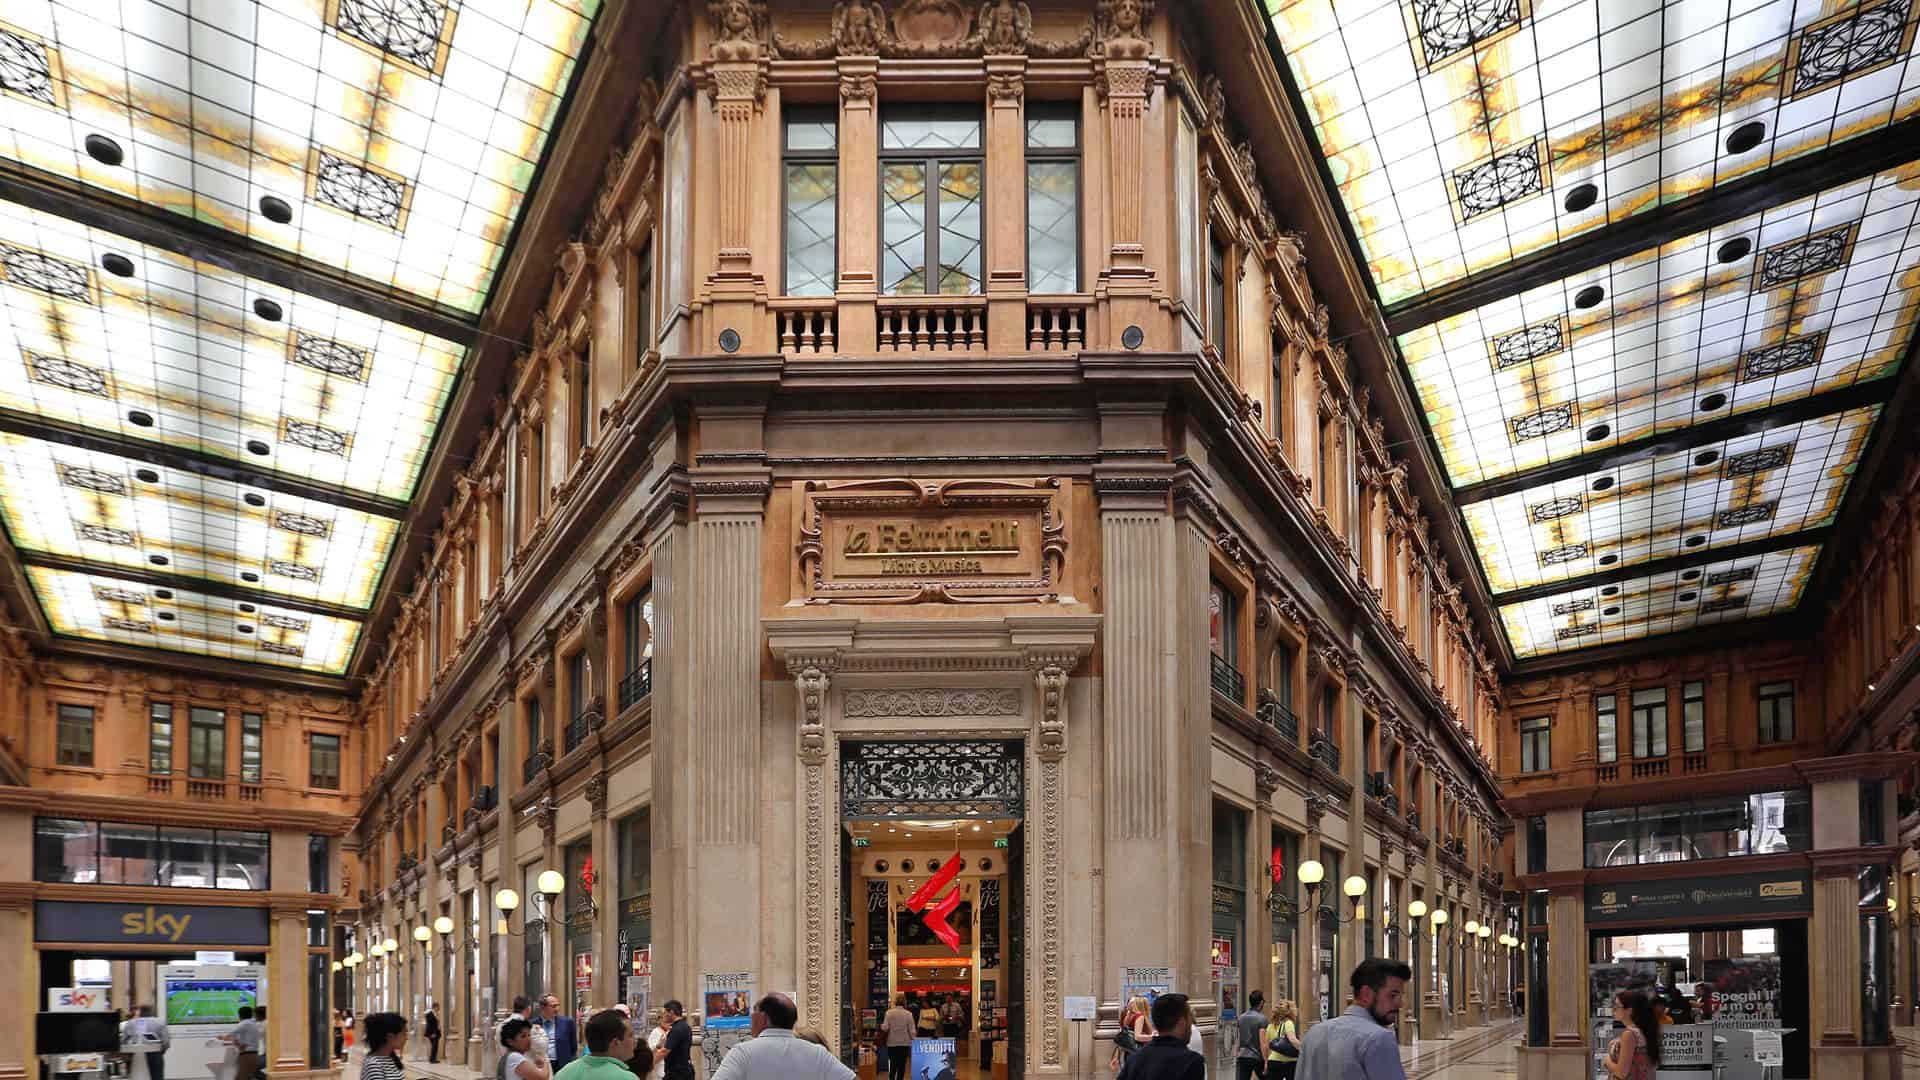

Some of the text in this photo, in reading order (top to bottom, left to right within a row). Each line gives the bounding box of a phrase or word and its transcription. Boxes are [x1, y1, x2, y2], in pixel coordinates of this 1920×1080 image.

[843, 520, 1021, 553] la Feltrinelli
[881, 557, 983, 575] Libri e Musica
[121, 906, 192, 942] sky
[59, 991, 97, 1009] sky
[1711, 991, 1761, 1003] Spegni
[1713, 1010, 1760, 1020] ccendi
[1662, 1031, 1694, 1041] pegni
